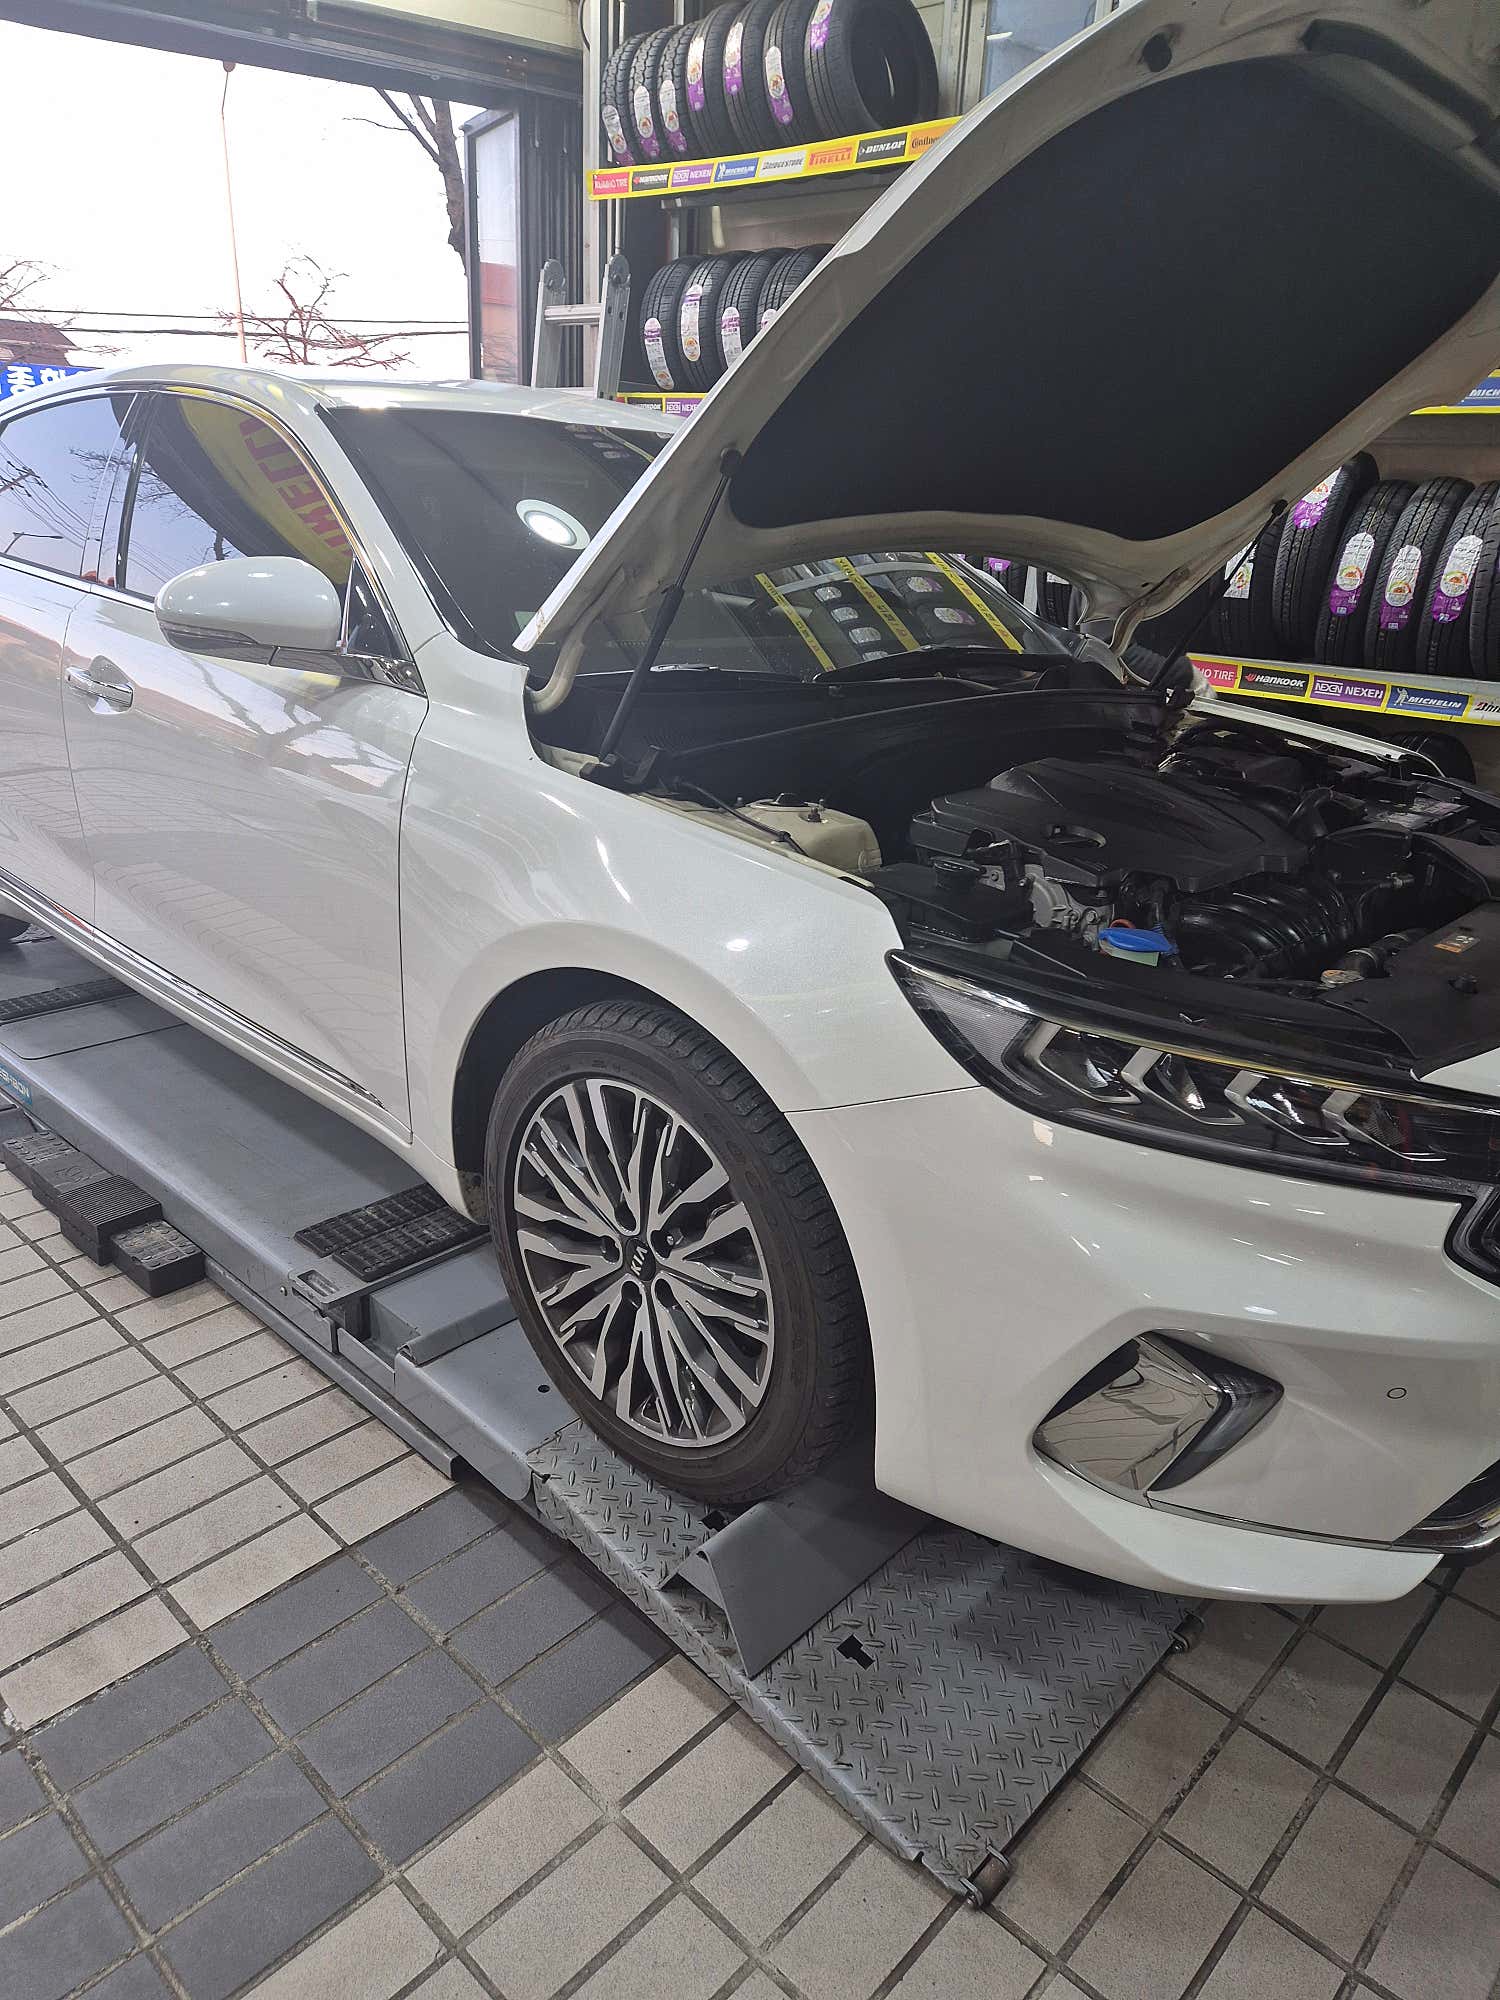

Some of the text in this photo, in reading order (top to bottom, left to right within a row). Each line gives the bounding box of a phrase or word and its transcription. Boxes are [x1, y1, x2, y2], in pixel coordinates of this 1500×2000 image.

[866, 140, 906, 154] DUNLOP
[809, 147, 853, 166] PIRELLI
[1213, 669, 1235, 681] TIRE
[1344, 686, 1384, 699] NEXEN
[1408, 696, 1463, 709] MICHELIN
[631, 1246, 648, 1276] KIA
